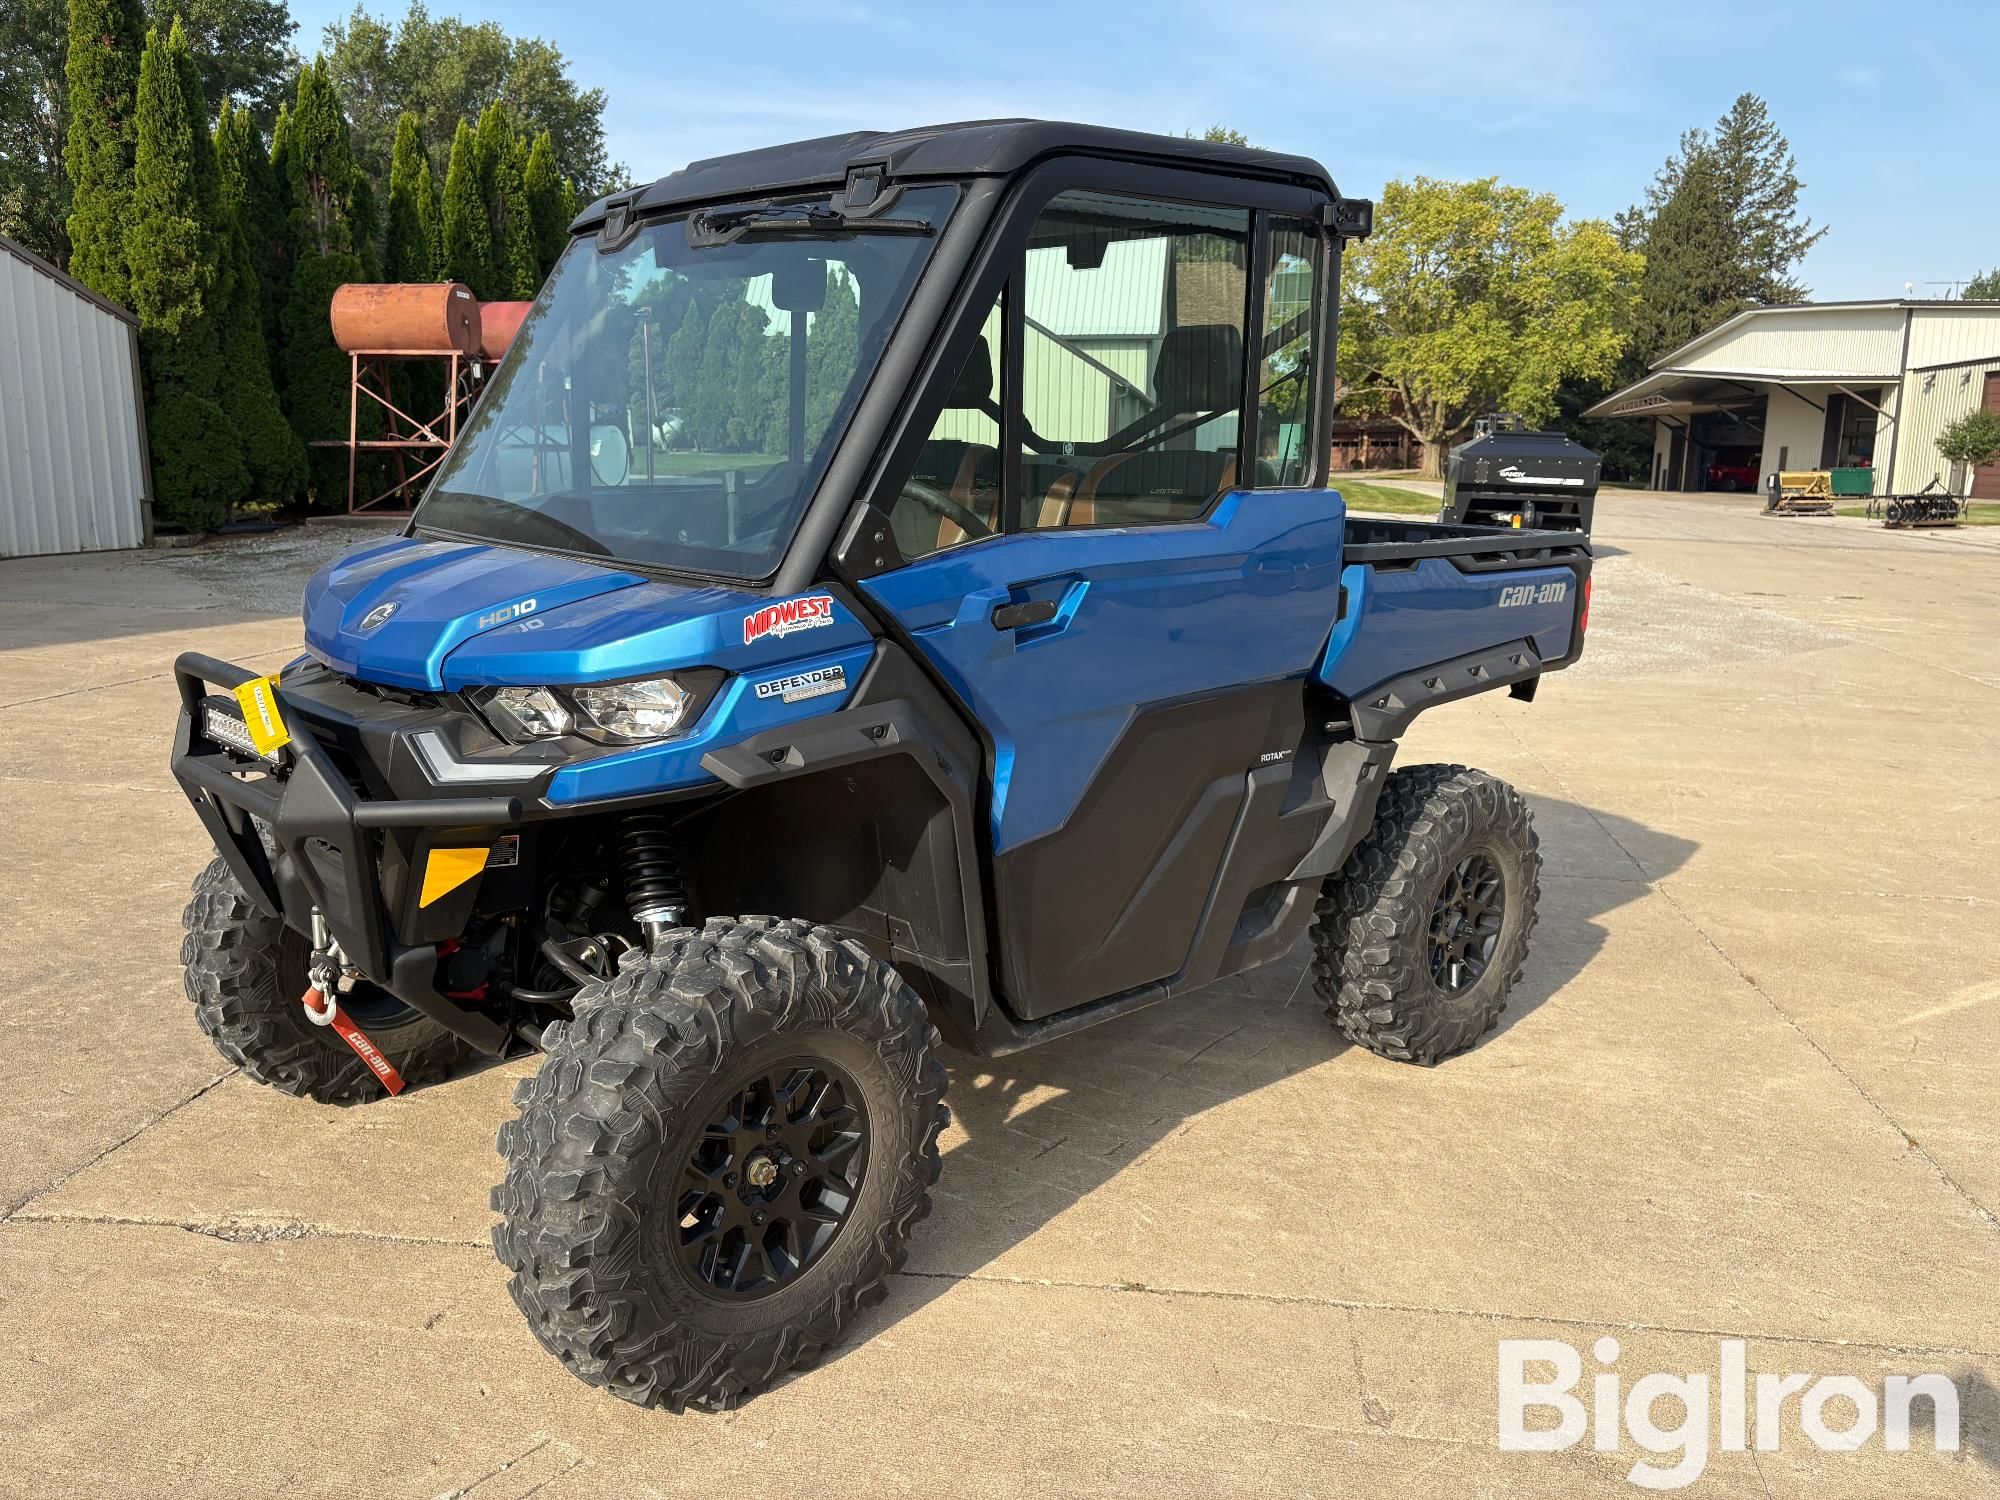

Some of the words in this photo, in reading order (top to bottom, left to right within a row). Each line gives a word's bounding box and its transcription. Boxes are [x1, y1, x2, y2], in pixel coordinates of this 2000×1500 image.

[479, 598, 537, 629] HD10
[744, 597, 833, 643] MIDWEST
[758, 667, 843, 696] DEFENDER
[1260, 751, 1284, 762] ROTAX
